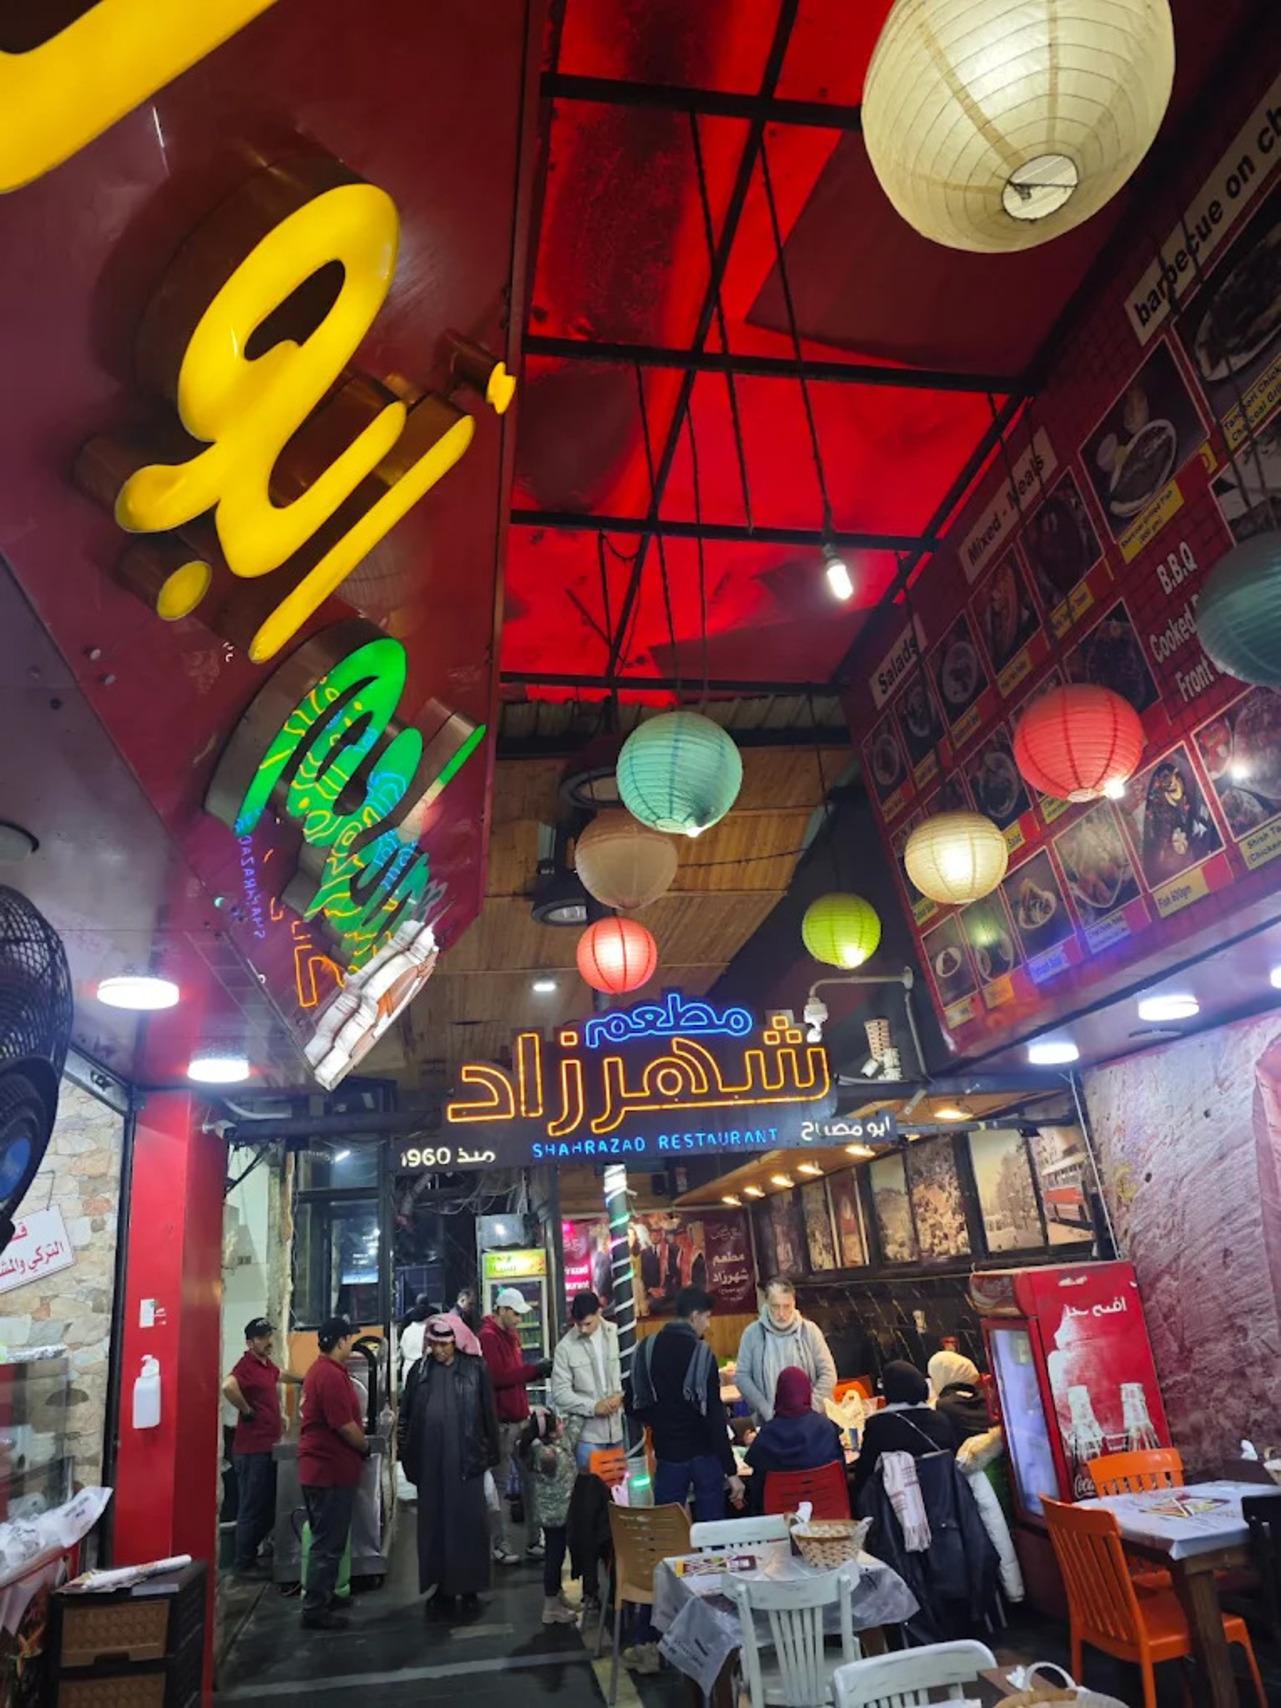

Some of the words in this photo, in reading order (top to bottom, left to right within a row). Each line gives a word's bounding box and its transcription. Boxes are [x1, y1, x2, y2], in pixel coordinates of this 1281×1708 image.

[1225, 155, 1255, 199] on
[967, 512, 1002, 566] Mixed
[1156, 541, 1198, 595] B.B.Q
[1150, 603, 1199, 663] Cooked
[878, 634, 919, 695] Salads
[585, 993, 753, 1048] مطعم
[447, 1014, 832, 1137] شهرزاد
[401, 1147, 451, 1168] 1960
[532, 1137, 646, 1159] SHAHRAZAD
[658, 1128, 778, 1150] RESTAURANT
